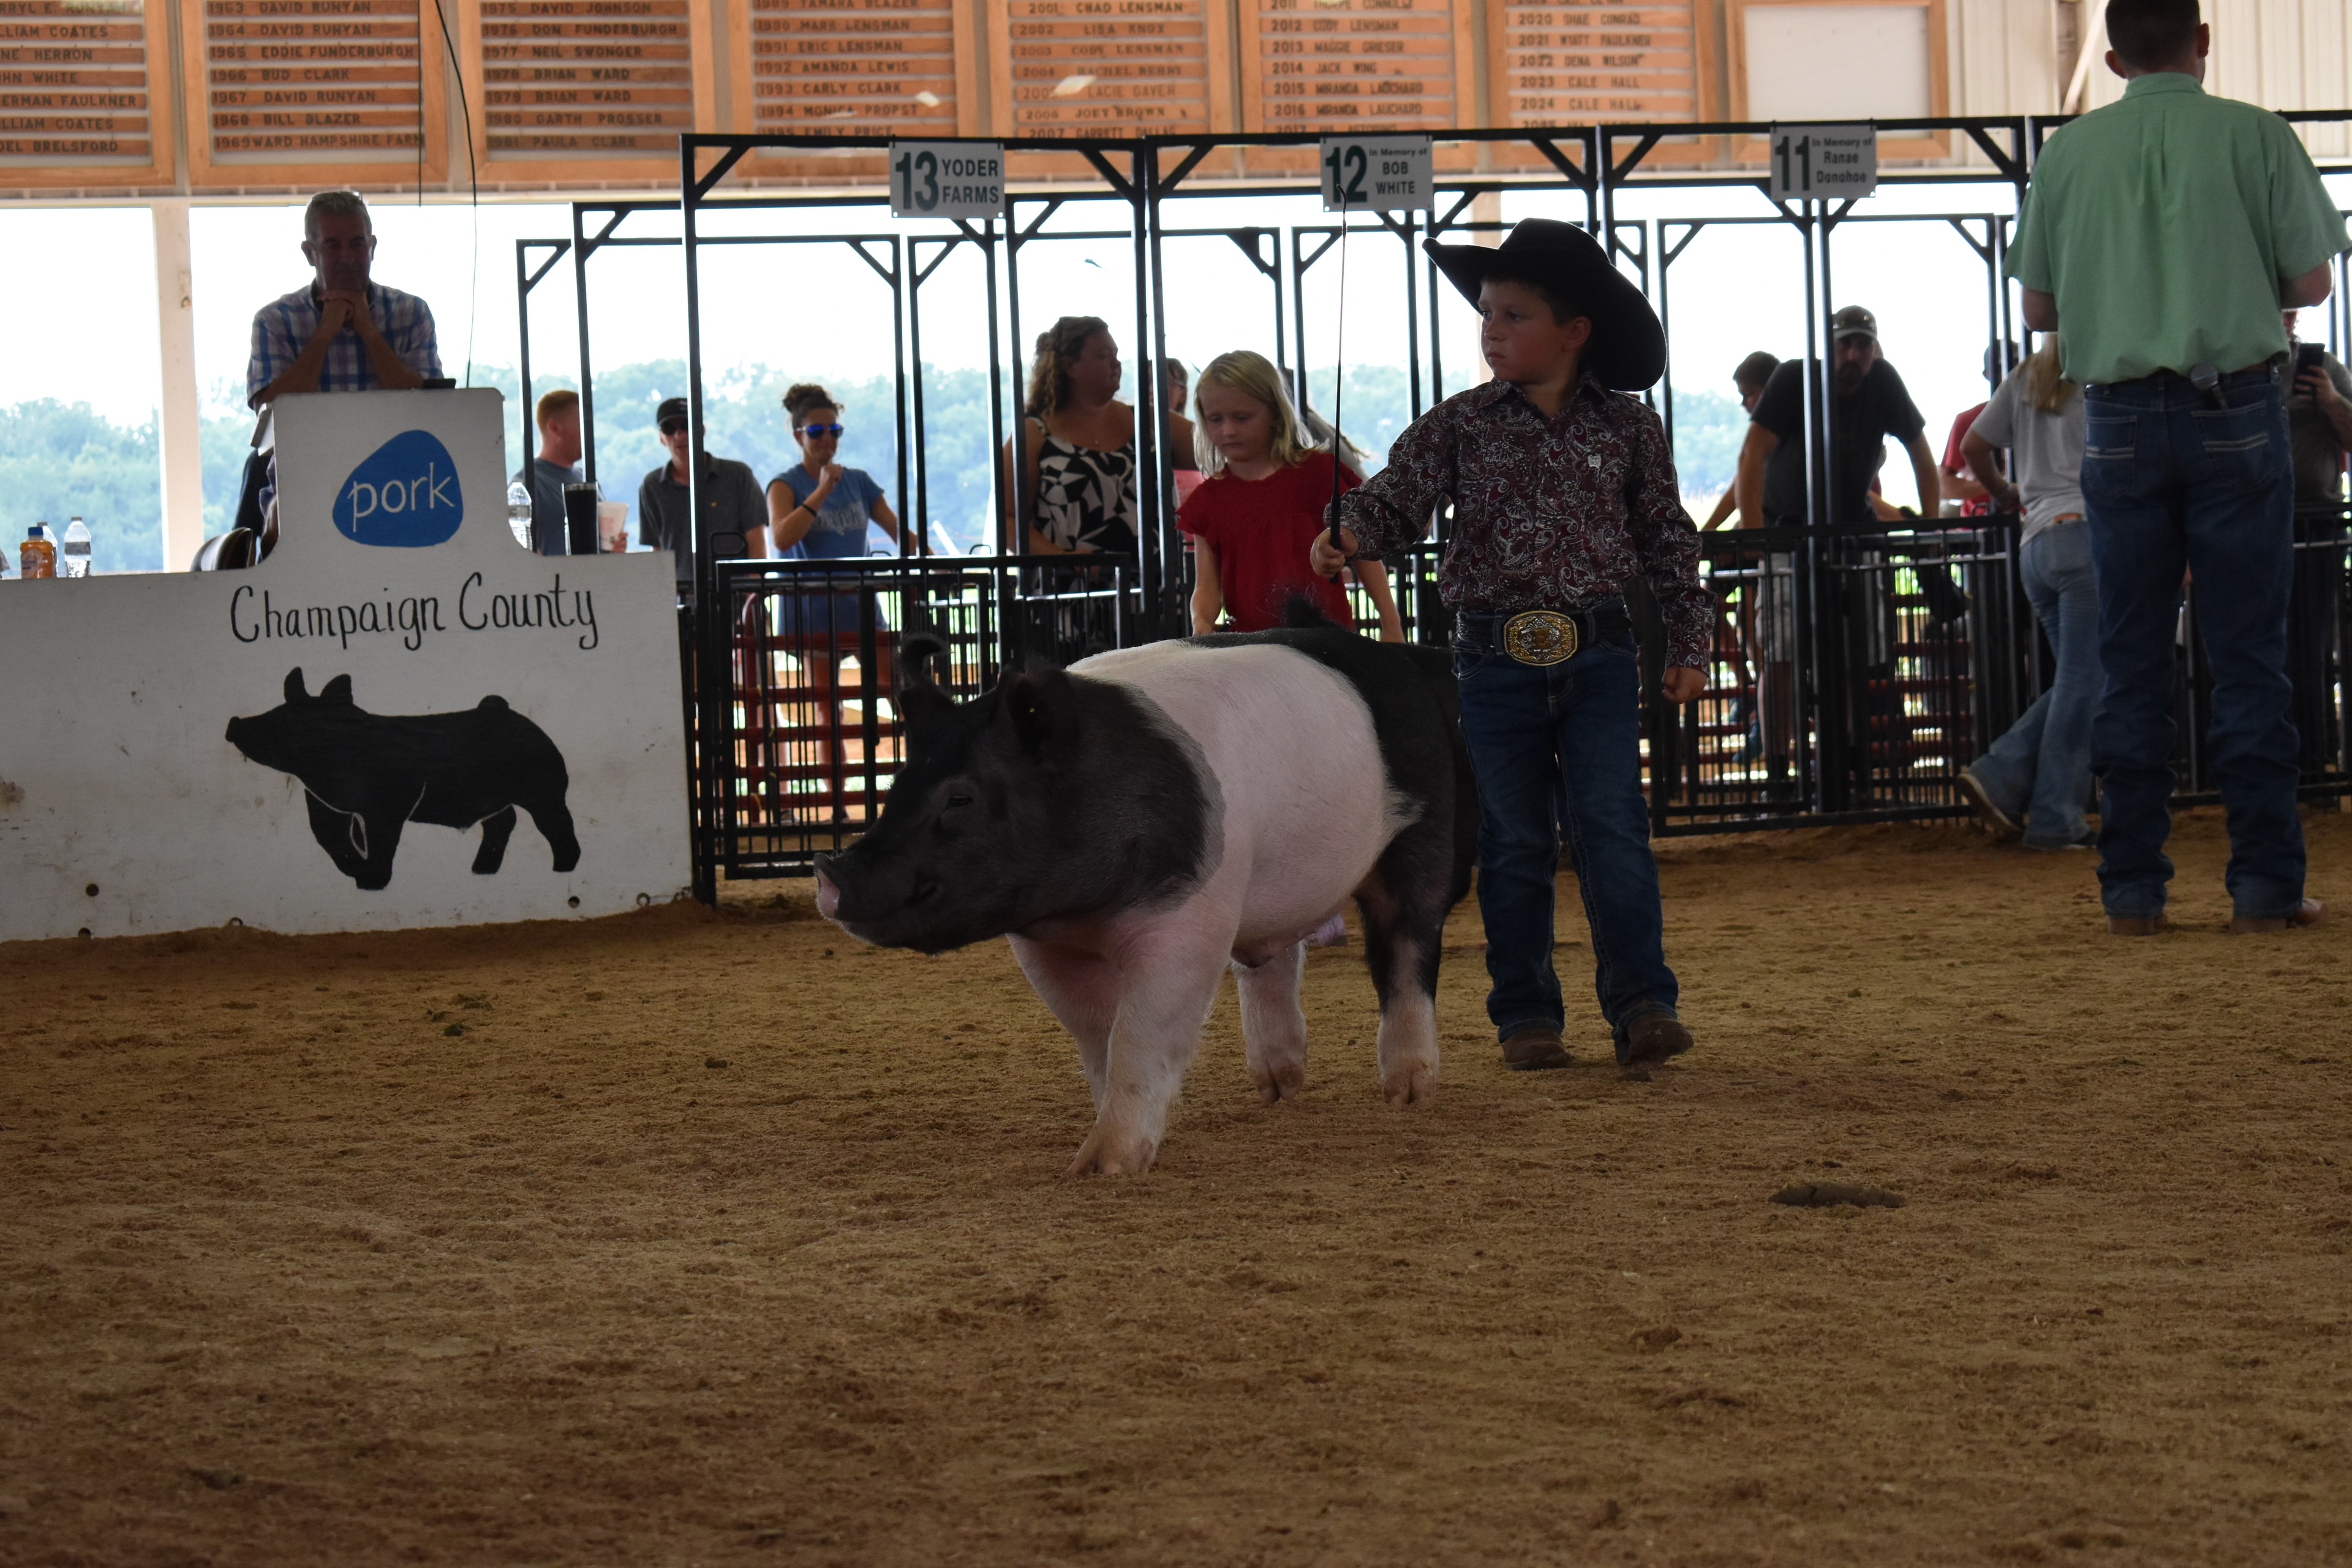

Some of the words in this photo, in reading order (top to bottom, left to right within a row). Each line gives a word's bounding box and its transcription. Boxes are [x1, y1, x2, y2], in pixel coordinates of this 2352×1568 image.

[209, 2, 244, 13] 1963
[260, 2, 303, 12] DAVID
[312, 1, 371, 12] RUNYAN
[531, 2, 573, 13] DAVID
[586, 2, 652, 12] JOHNSON
[1029, 2, 1058, 14] 2001
[1076, 2, 1111, 13] CHAD
[1119, 1, 1183, 13] LENSMAN
[1519, 13, 1552, 25] 2020
[50, 26, 108, 37] COATES
[210, 25, 244, 36] 1964
[261, 24, 303, 36] DAVID
[313, 24, 371, 35] RUNYAN
[532, 24, 562, 36] DON
[575, 23, 677, 35] FUNDERBURGH
[801, 20, 836, 31] MARK
[846, 20, 910, 30] LENSMAN
[1020, 24, 1054, 36] 2002
[1084, 24, 1115, 35] LISA
[1129, 24, 1164, 34] KNOX
[1272, 20, 1302, 31] 2012
[1519, 34, 1548, 46] 2021
[1560, 34, 1590, 46] WYATT
[211, 47, 245, 58] 1965
[262, 47, 303, 58] EDDIE
[310, 45, 413, 57] FUNDERBURGH
[484, 47, 518, 57] 1977
[532, 47, 562, 58] NEIL
[575, 45, 643, 56] SWONGER
[798, 42, 827, 53] ERIC
[839, 41, 902, 52] LENSMAN
[1116, 43, 1183, 55] LENSMAN
[1273, 41, 1303, 53] 2013
[34, 49, 92, 60] HERRON
[802, 62, 858, 73] AMANDA
[869, 61, 909, 72] LEWIS
[1520, 55, 1553, 67] 2022
[534, 69, 576, 80] BRIAN
[591, 68, 630, 79] WARD
[1273, 62, 1303, 74] 2014
[1316, 62, 1341, 74] JACK
[1354, 62, 1376, 74] WING
[0, 73, 21, 83] HN
[32, 72, 77, 83] WHITE
[262, 69, 290, 80] BUD
[304, 69, 349, 80] CLARK
[804, 83, 847, 94] CARLY
[858, 82, 901, 93] CLARK
[1521, 77, 1554, 88] 2023
[1569, 76, 1596, 88] CALE
[1611, 77, 1639, 88] HALL
[1275, 83, 1305, 94] 2015
[62, 95, 136, 107] FAULKNER
[212, 92, 246, 104] 1967
[265, 92, 307, 103] DAVID
[317, 92, 375, 102] RUNYAN
[536, 91, 578, 102] BRIAN
[593, 91, 631, 102] WARD
[761, 106, 793, 116] 1994
[804, 105, 853, 116] MONICA
[865, 104, 918, 115] PROPST
[1275, 104, 1305, 116] 2016
[1521, 98, 1554, 110] 2024
[1569, 98, 1599, 110] CALE
[1610, 98, 1638, 110] HALL
[537, 113, 581, 124] GARTH
[598, 113, 662, 124] PROSSER
[1076, 108, 1108, 119] JOEY
[1116, 107, 1164, 118] BROWN
[56, 118, 113, 129] COATES
[214, 115, 249, 126] 1968
[264, 115, 295, 126] BILL
[306, 114, 360, 125] BLAZER
[33, 141, 118, 152] BRELSFORD
[216, 137, 250, 148] 1969
[253, 136, 292, 148] WARD
[300, 135, 379, 147] HAMPSHIRE
[533, 136, 578, 147] PAULA
[592, 136, 637, 147] CLARK
[942, 159, 998, 176] YODER
[1382, 162, 1408, 175] BOB
[1775, 135, 1809, 191] 11
[1325, 145, 1367, 203] 12
[895, 151, 939, 211] 13
[1376, 181, 1415, 195] WHITE
[943, 186, 999, 204] FARMS
[347, 462, 456, 533] pork
[230, 585, 446, 650] Champaign
[459, 571, 599, 650] County
